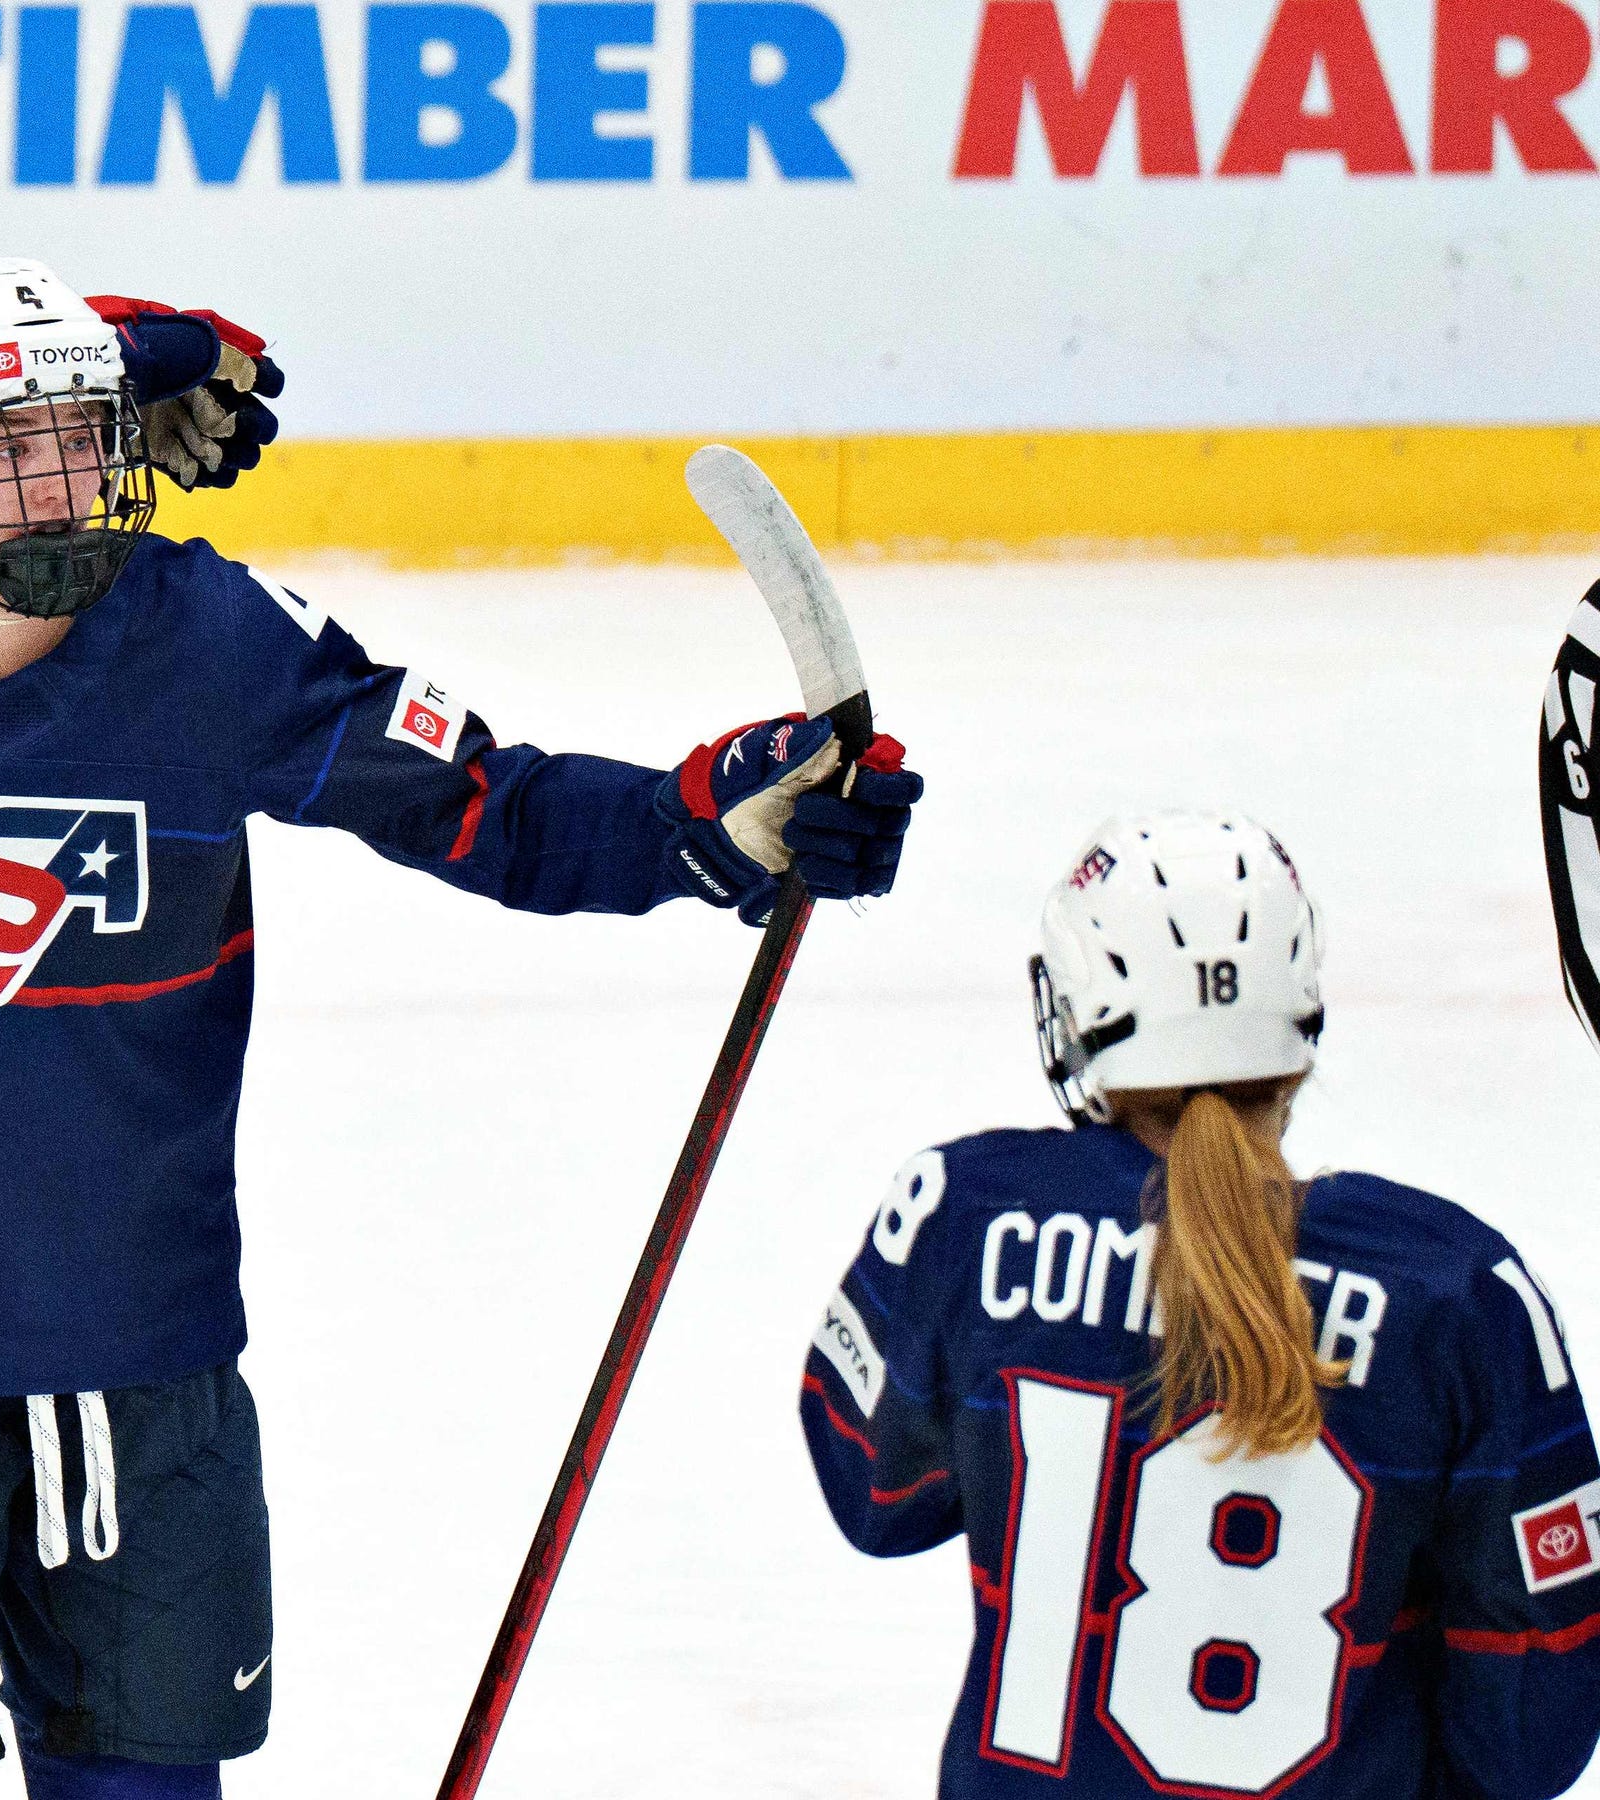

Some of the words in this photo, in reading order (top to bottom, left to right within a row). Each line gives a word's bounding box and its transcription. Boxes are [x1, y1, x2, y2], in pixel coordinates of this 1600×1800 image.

[951, 0, 1600, 182] MAR
[16, 286, 44, 310] 4
[29, 346, 103, 366] TOYOTA
[1563, 739, 1590, 800] 6
[1193, 959, 1239, 1008] 18
[979, 1366, 1375, 1800] 18
